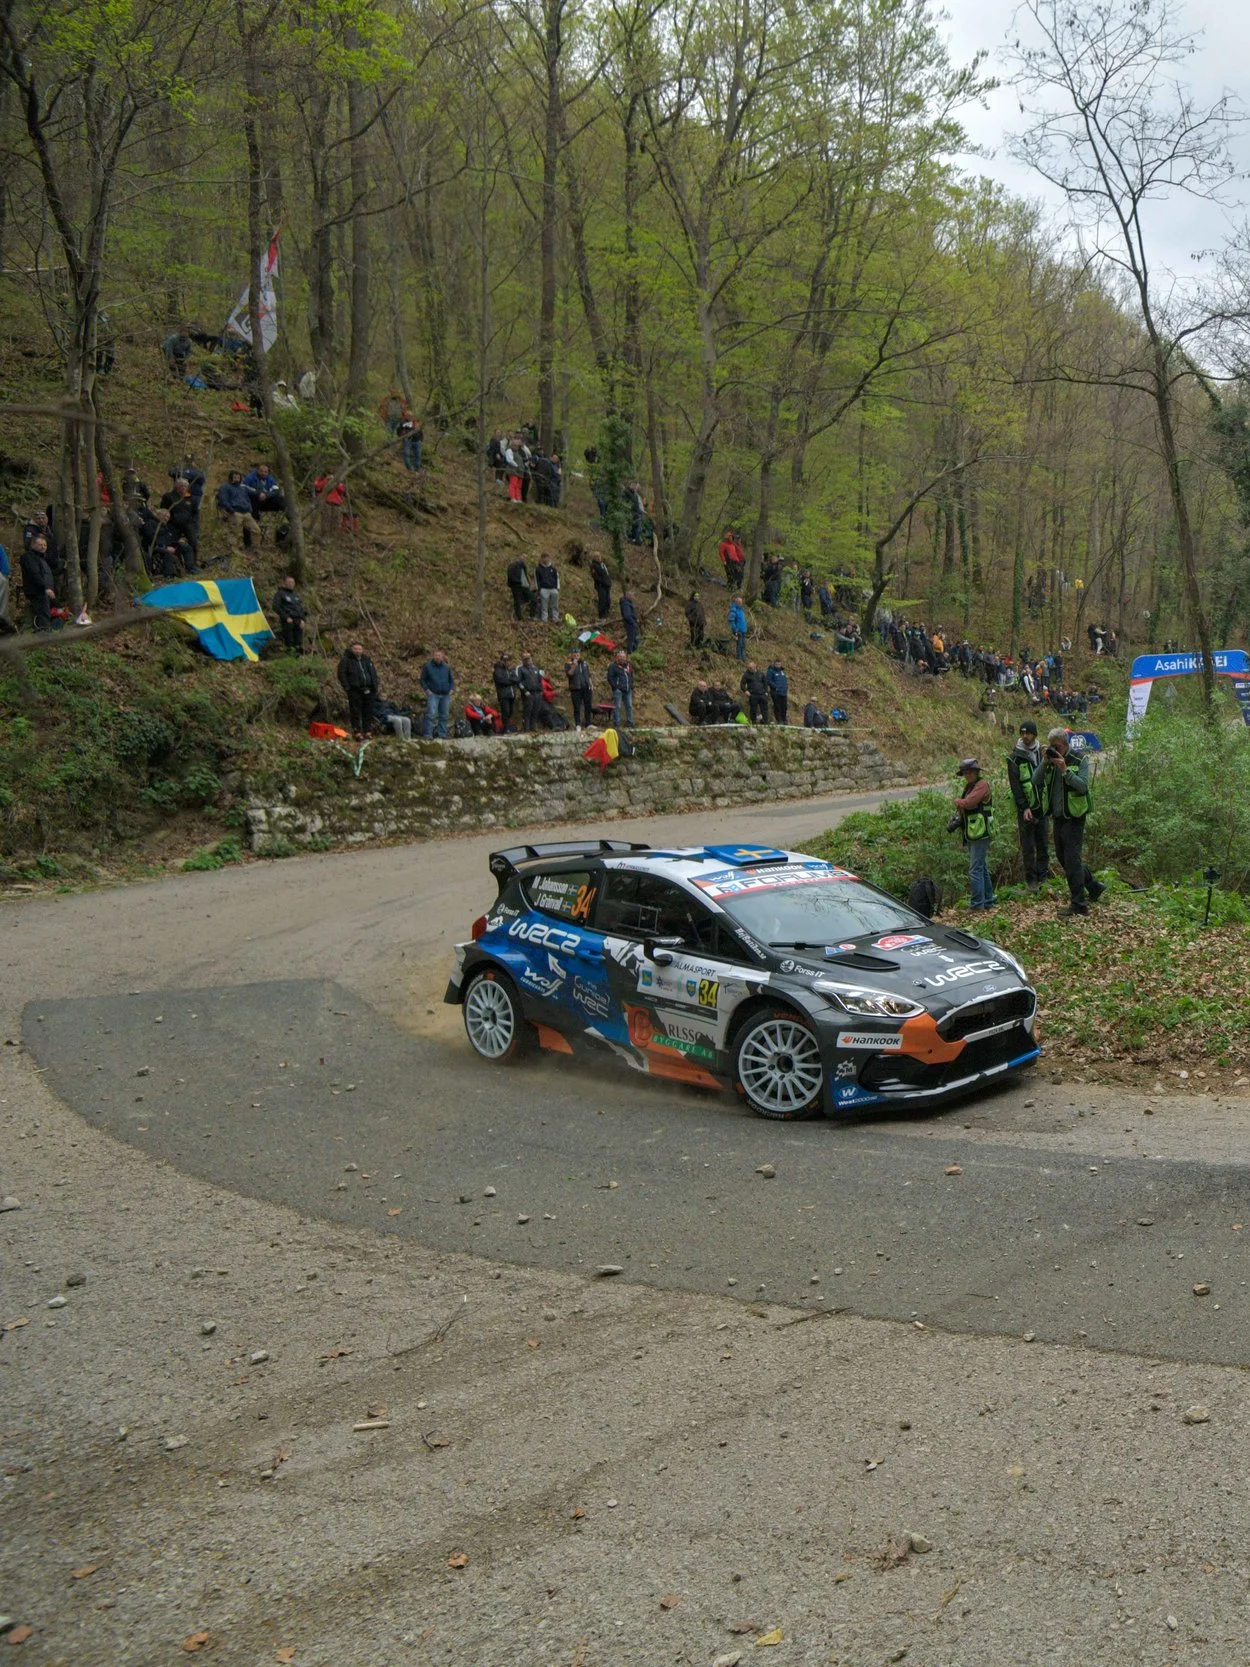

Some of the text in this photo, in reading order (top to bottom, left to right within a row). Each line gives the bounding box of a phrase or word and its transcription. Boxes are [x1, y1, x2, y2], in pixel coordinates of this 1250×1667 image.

[571, 885, 597, 919] 34
[508, 918, 580, 955] WRC2
[794, 965, 825, 978] Forss IT
[924, 960, 1005, 986] WRC2
[700, 980, 718, 1007] 34
